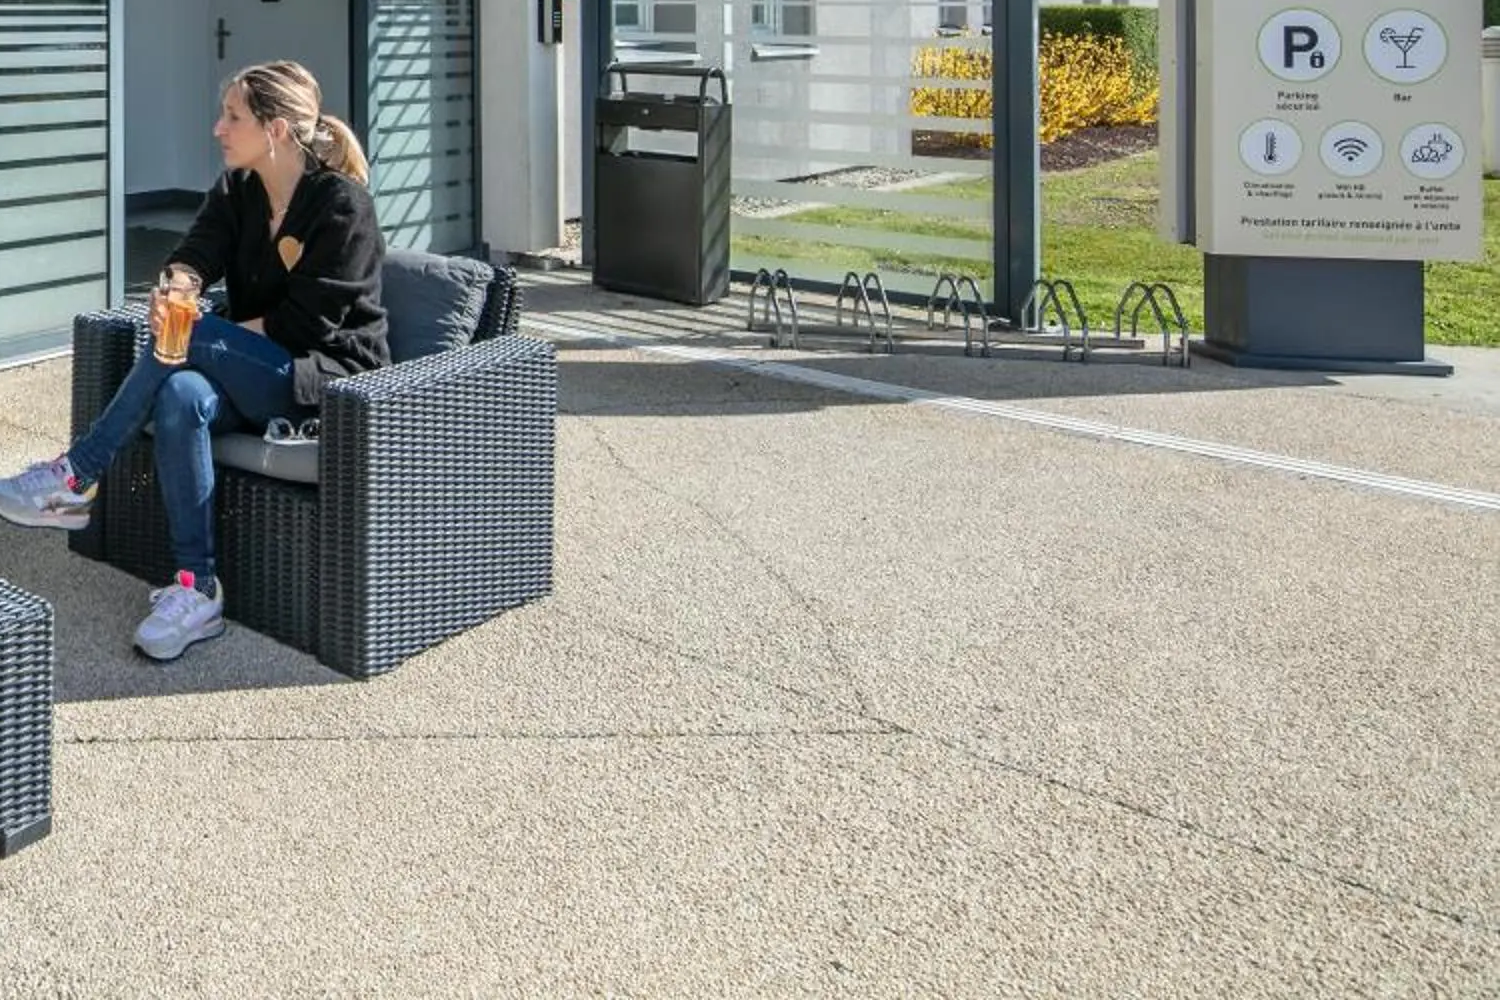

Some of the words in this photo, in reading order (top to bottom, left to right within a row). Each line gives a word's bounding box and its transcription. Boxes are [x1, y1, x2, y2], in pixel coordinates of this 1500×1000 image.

[1277, 90, 1319, 102] Parking
[1393, 93, 1412, 103] Bar
[1240, 216, 1299, 227] Prestation
